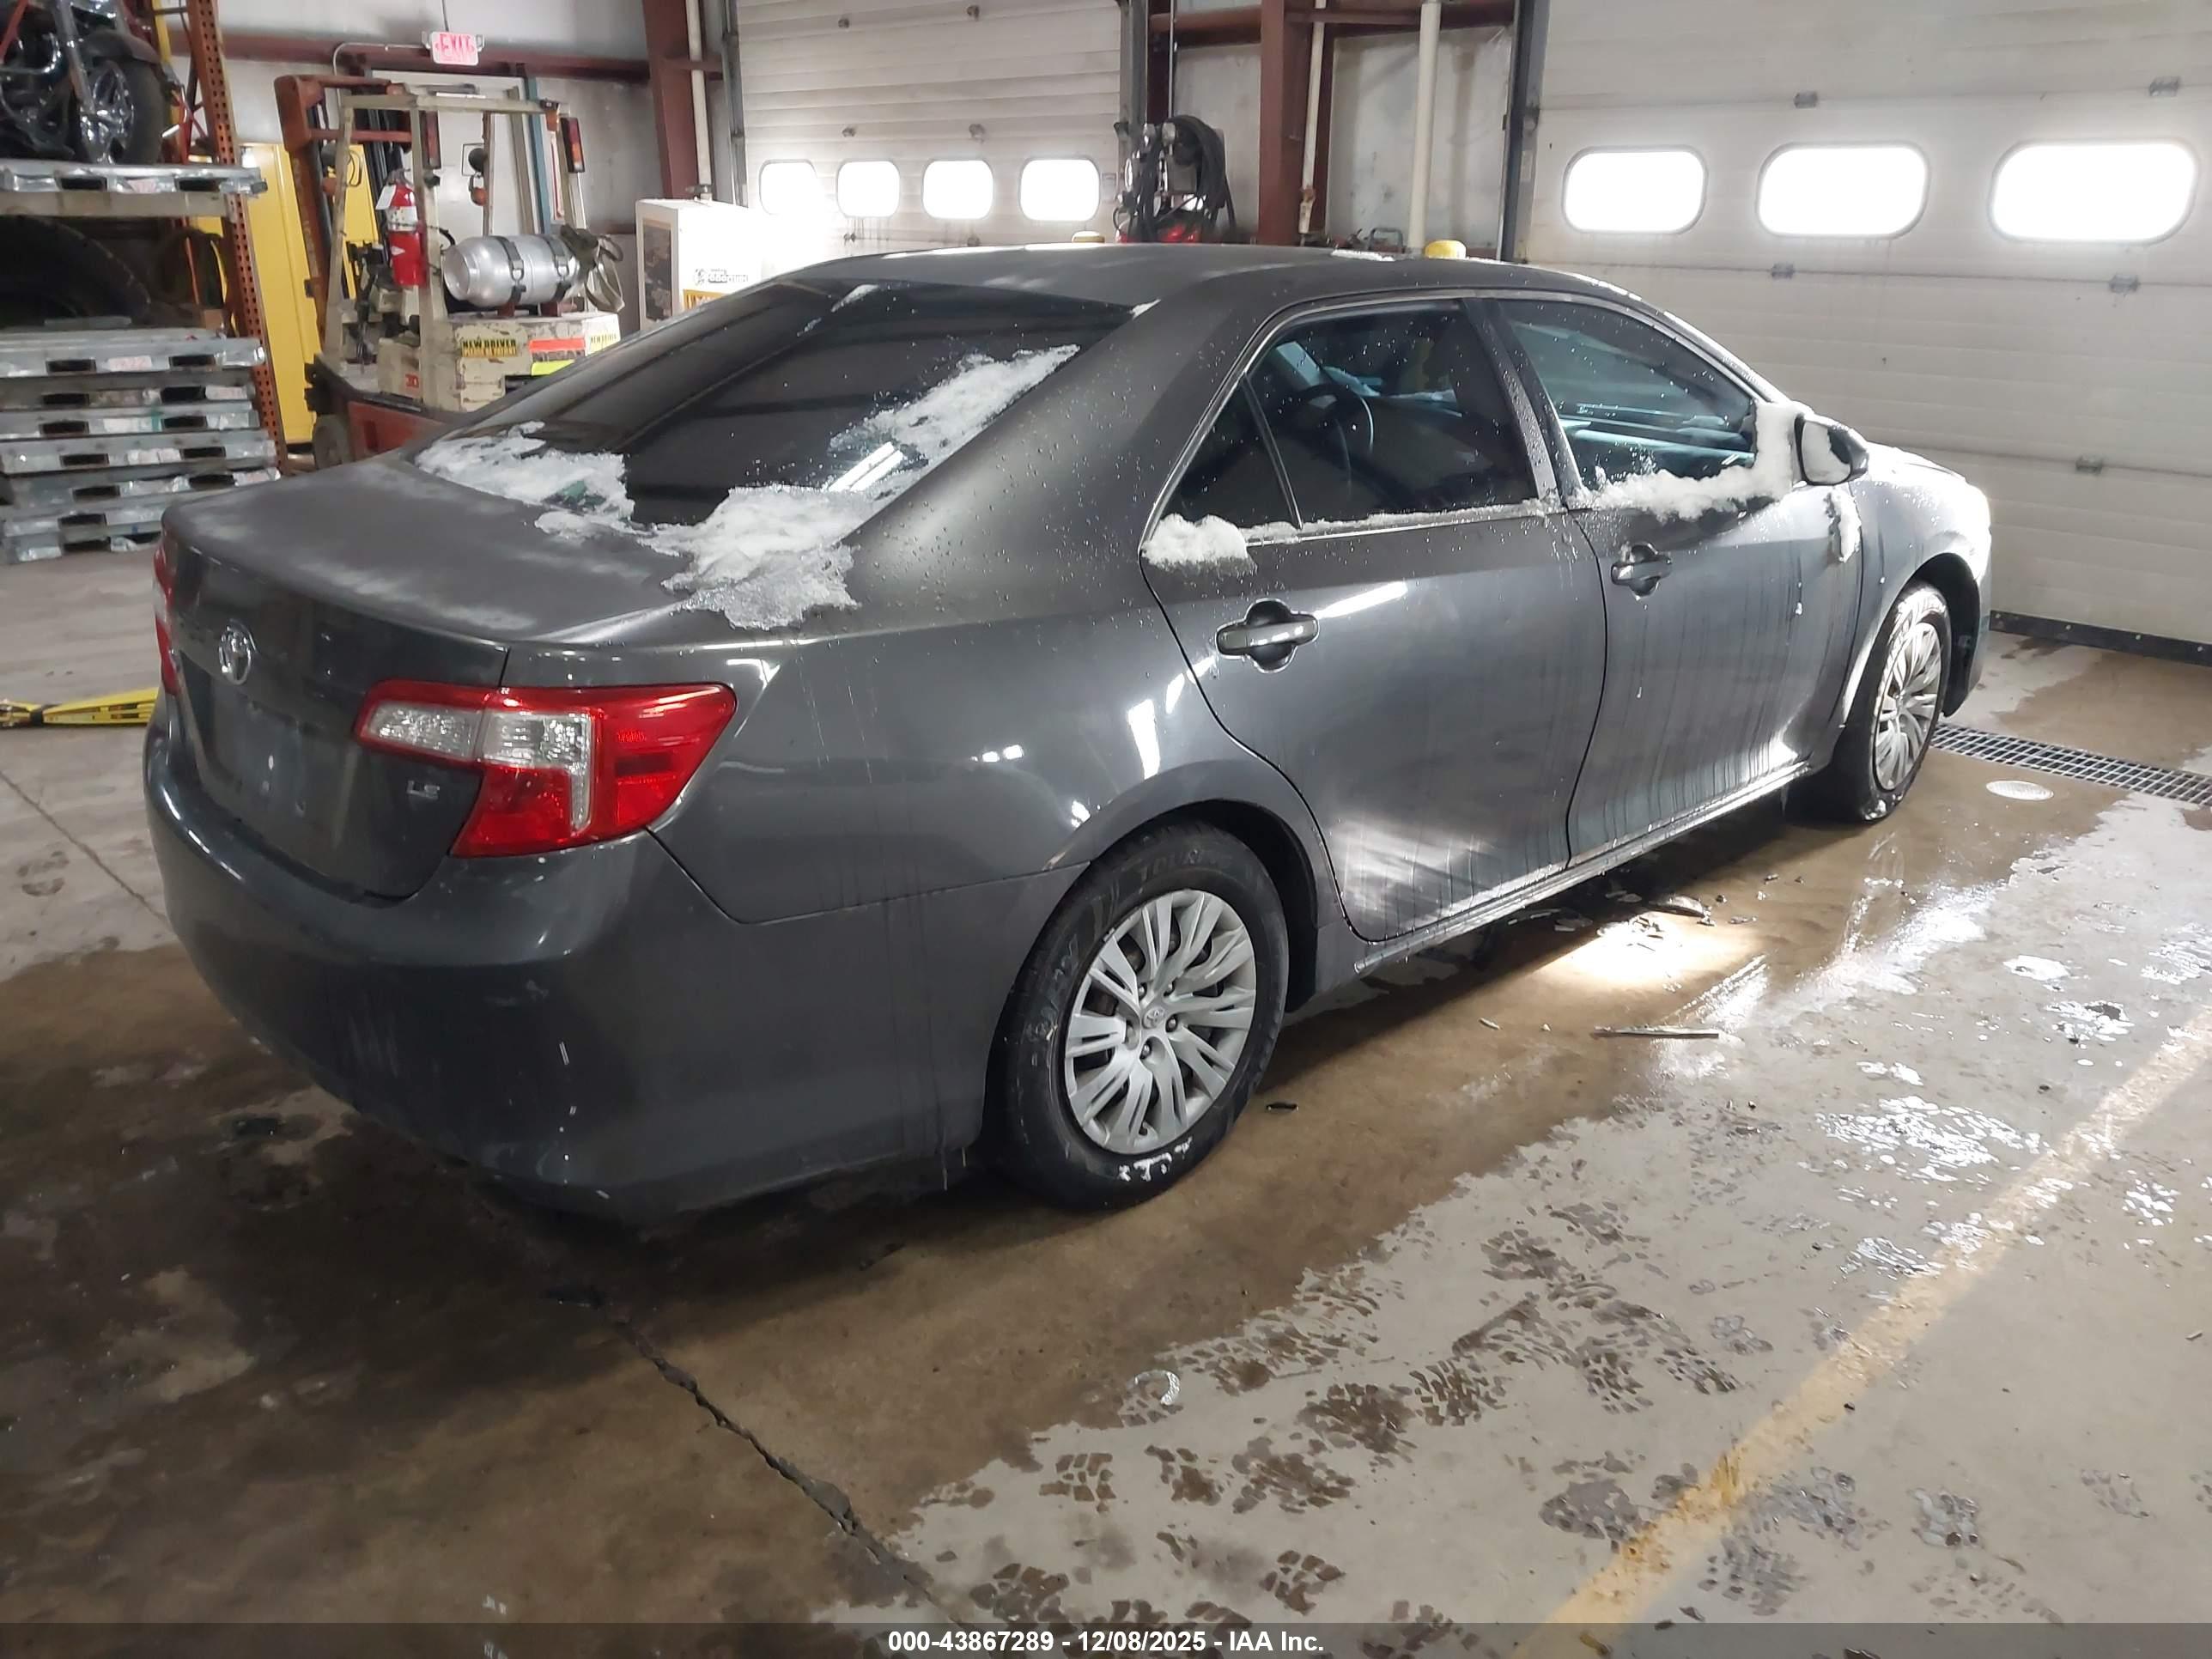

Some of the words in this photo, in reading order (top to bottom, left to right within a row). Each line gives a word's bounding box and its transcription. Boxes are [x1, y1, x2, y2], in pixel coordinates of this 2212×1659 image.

[439, 33, 471, 54] EXIT
[463, 338, 482, 348] NEW
[483, 338, 516, 347] DRIVER
[406, 780, 440, 799] LE
